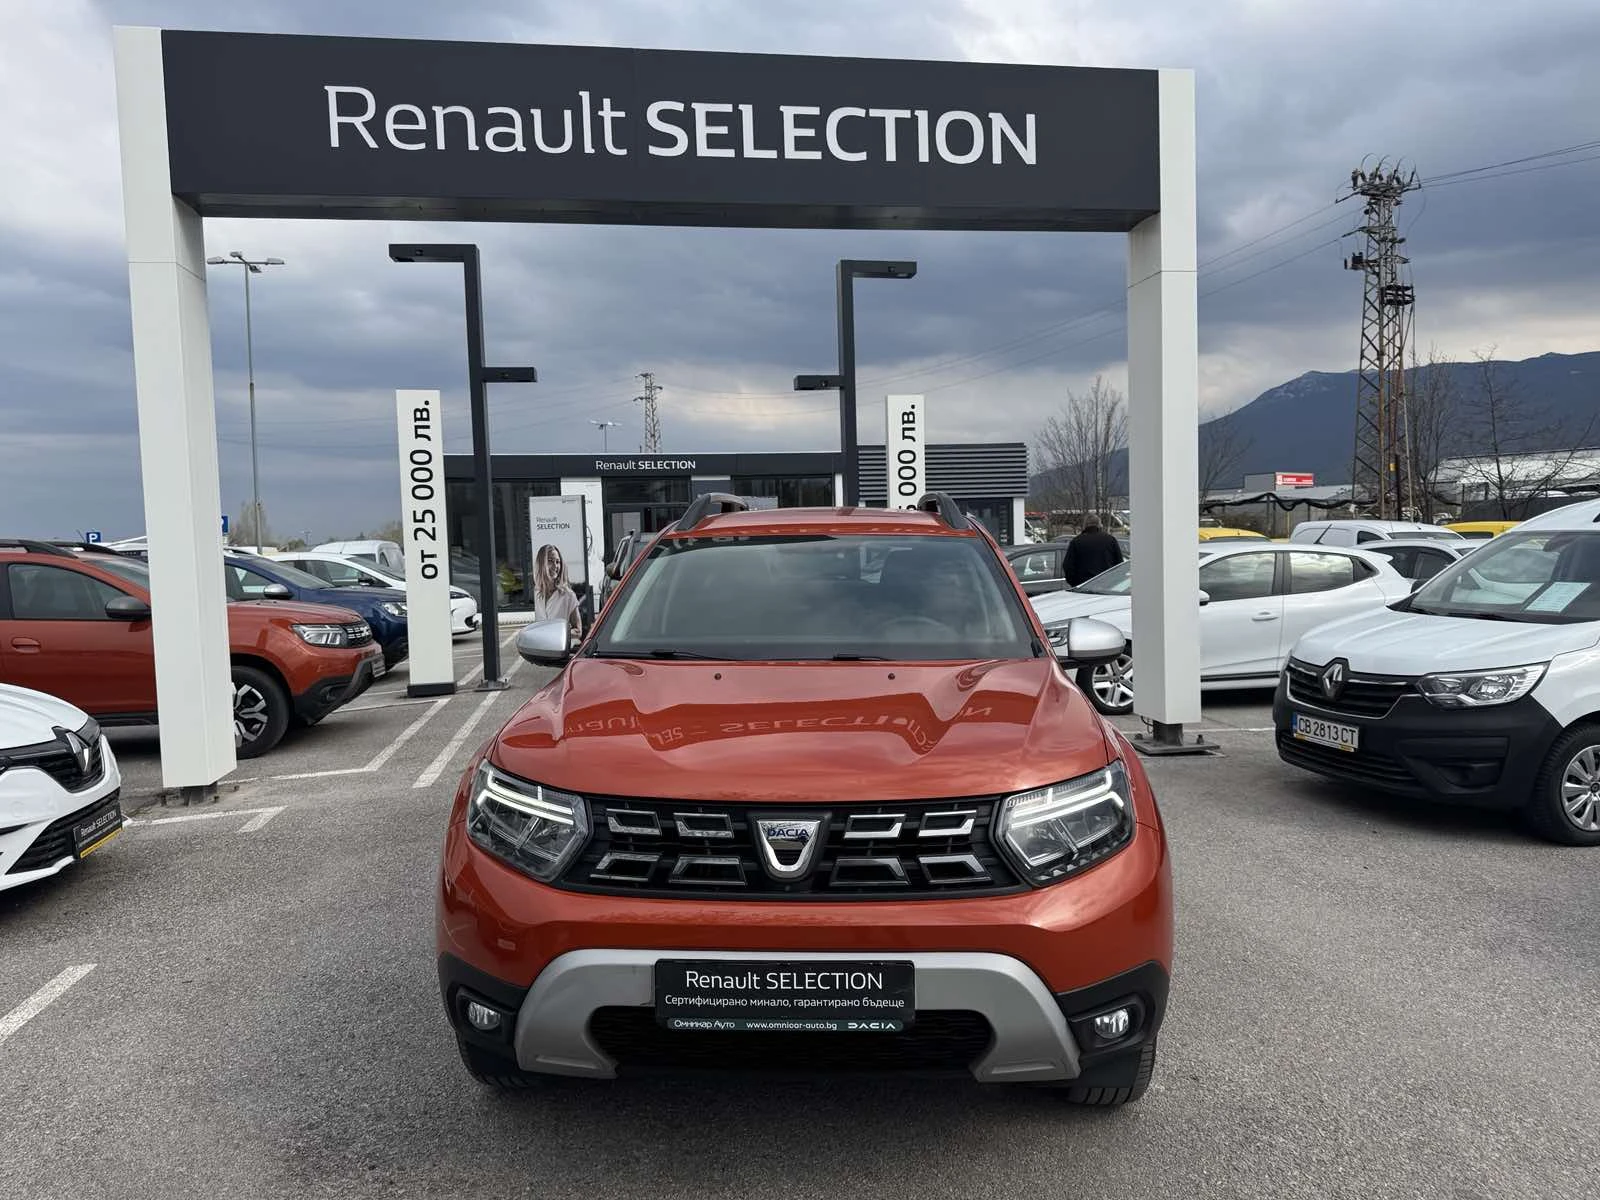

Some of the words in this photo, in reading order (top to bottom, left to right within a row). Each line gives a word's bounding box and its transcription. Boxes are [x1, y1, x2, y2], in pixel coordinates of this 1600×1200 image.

[324, 85, 628, 156] Renault
[645, 100, 1037, 165] SELECTION
[414, 400, 431, 442] лв.
[901, 404, 916, 443] лв.
[410, 449, 434, 501] 000
[595, 460, 636, 470] Renault
[638, 460, 696, 470] SELECTION
[897, 449, 917, 497] 000
[89, 533, 98, 544] P
[413, 509, 436, 541] 25
[420, 549, 439, 580] от
[1298, 718, 1311, 734] CB
[1313, 721, 1339, 741] 2813
[1341, 727, 1356, 745] CT
[767, 828, 809, 837] DACIA
[686, 970, 760, 990] Renault
[766, 972, 883, 990] SELECTION
[665, 995, 748, 1008] Сертифицирано
[750, 998, 792, 1008] минало,
[793, 998, 860, 1009] гарантирано
[862, 997, 905, 1009] бъдеще
[674, 1019, 712, 1029] Омникар
[714, 1020, 736, 1029] Ауто
[847, 1022, 896, 1030] DACIA
